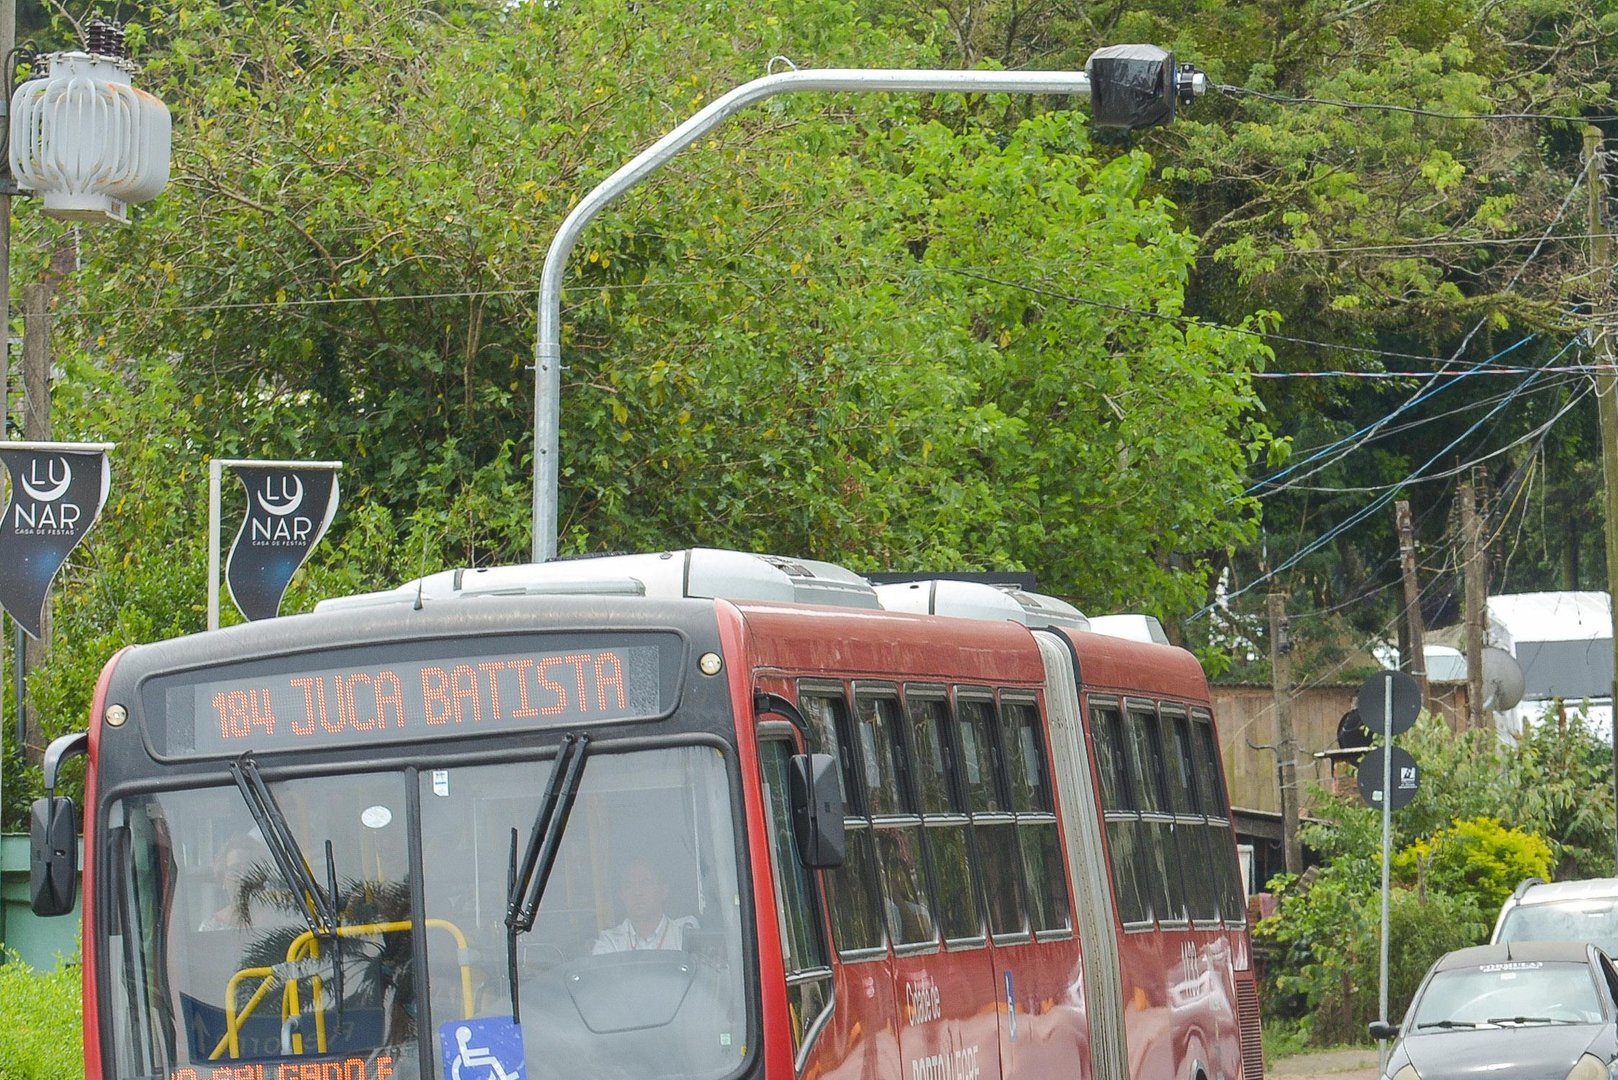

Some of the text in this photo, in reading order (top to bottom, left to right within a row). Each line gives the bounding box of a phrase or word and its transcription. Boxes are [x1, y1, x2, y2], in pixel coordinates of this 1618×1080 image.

[14, 503, 80, 529] NAR
[252, 516, 312, 540] NAR
[210, 651, 627, 739] 184 JUCA BATISTA
